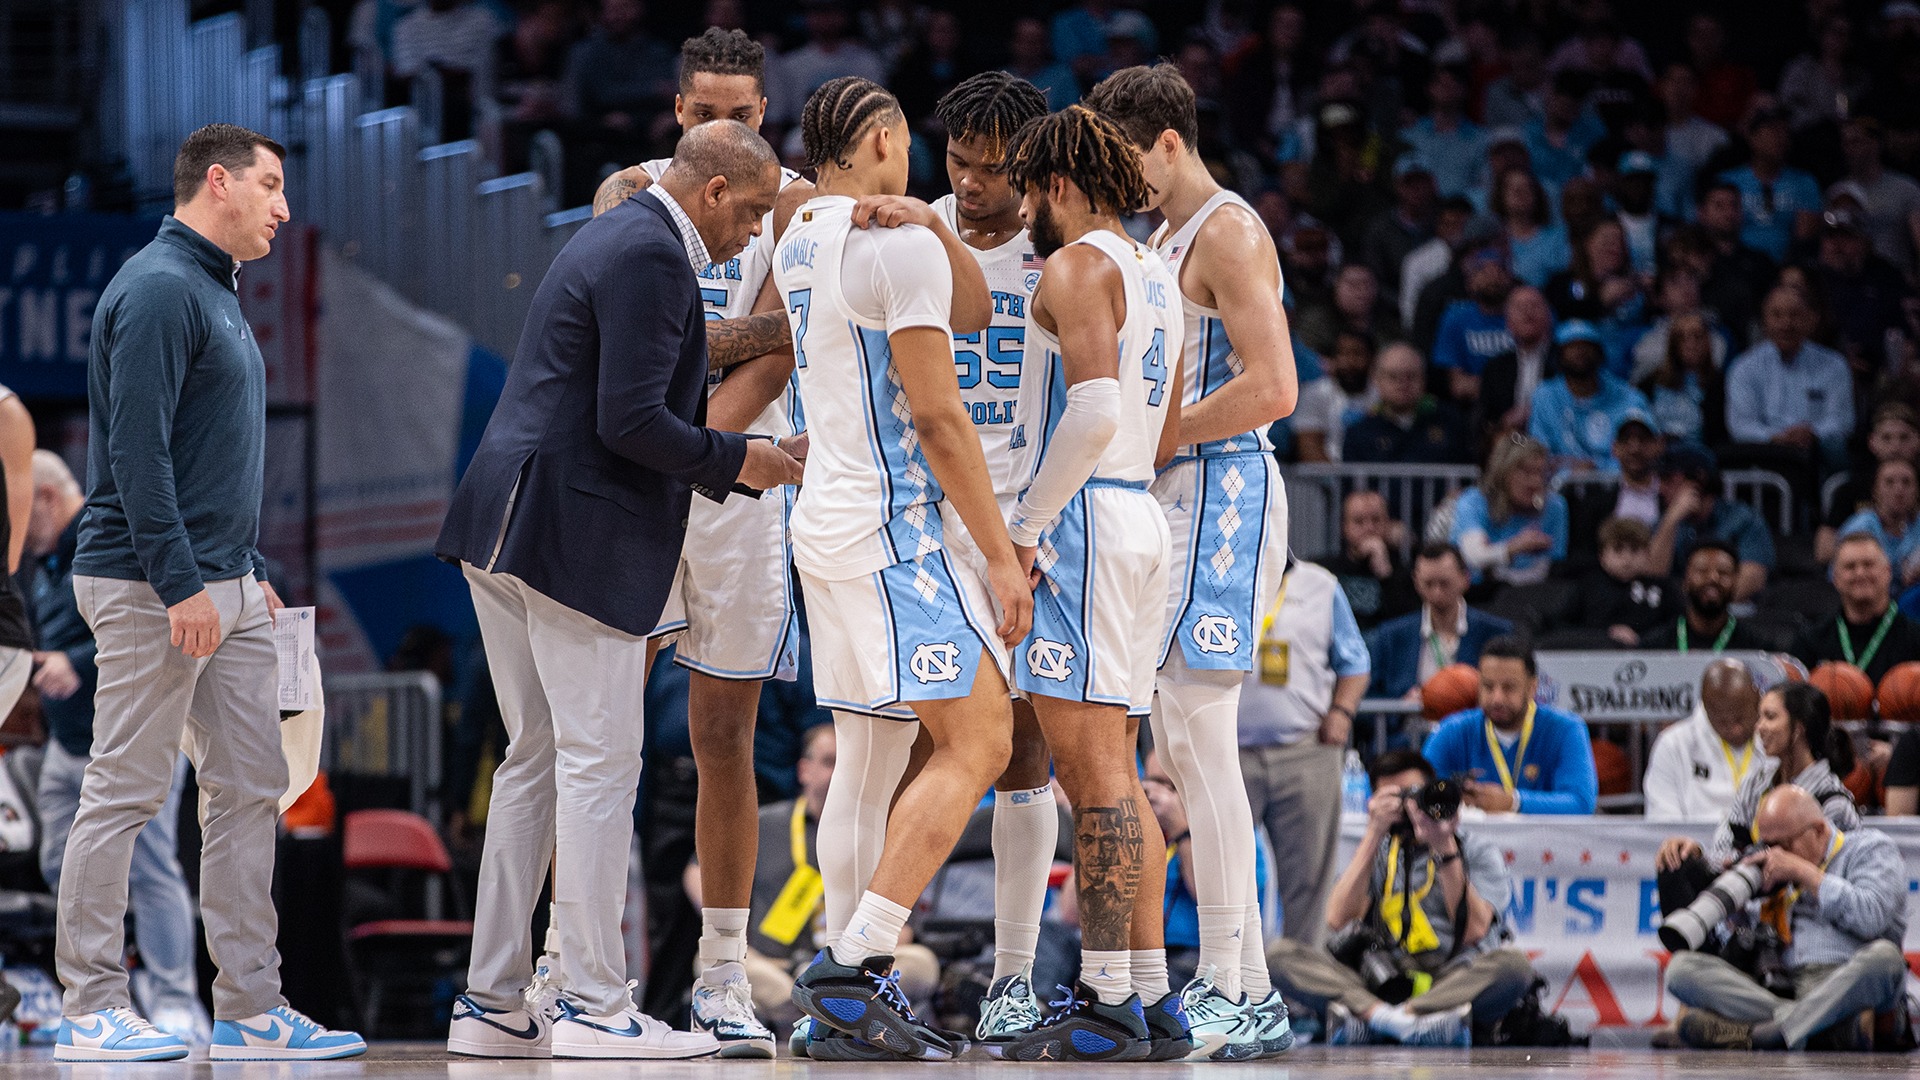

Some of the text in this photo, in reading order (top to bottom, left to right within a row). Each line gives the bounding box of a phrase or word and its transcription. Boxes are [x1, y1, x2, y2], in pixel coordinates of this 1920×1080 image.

[781, 238, 818, 274] TRIMBLE
[788, 287, 812, 370] 7
[953, 326, 1026, 389] 55
[1142, 327, 1168, 408] 4
[1571, 683, 1694, 714] SPALDING
